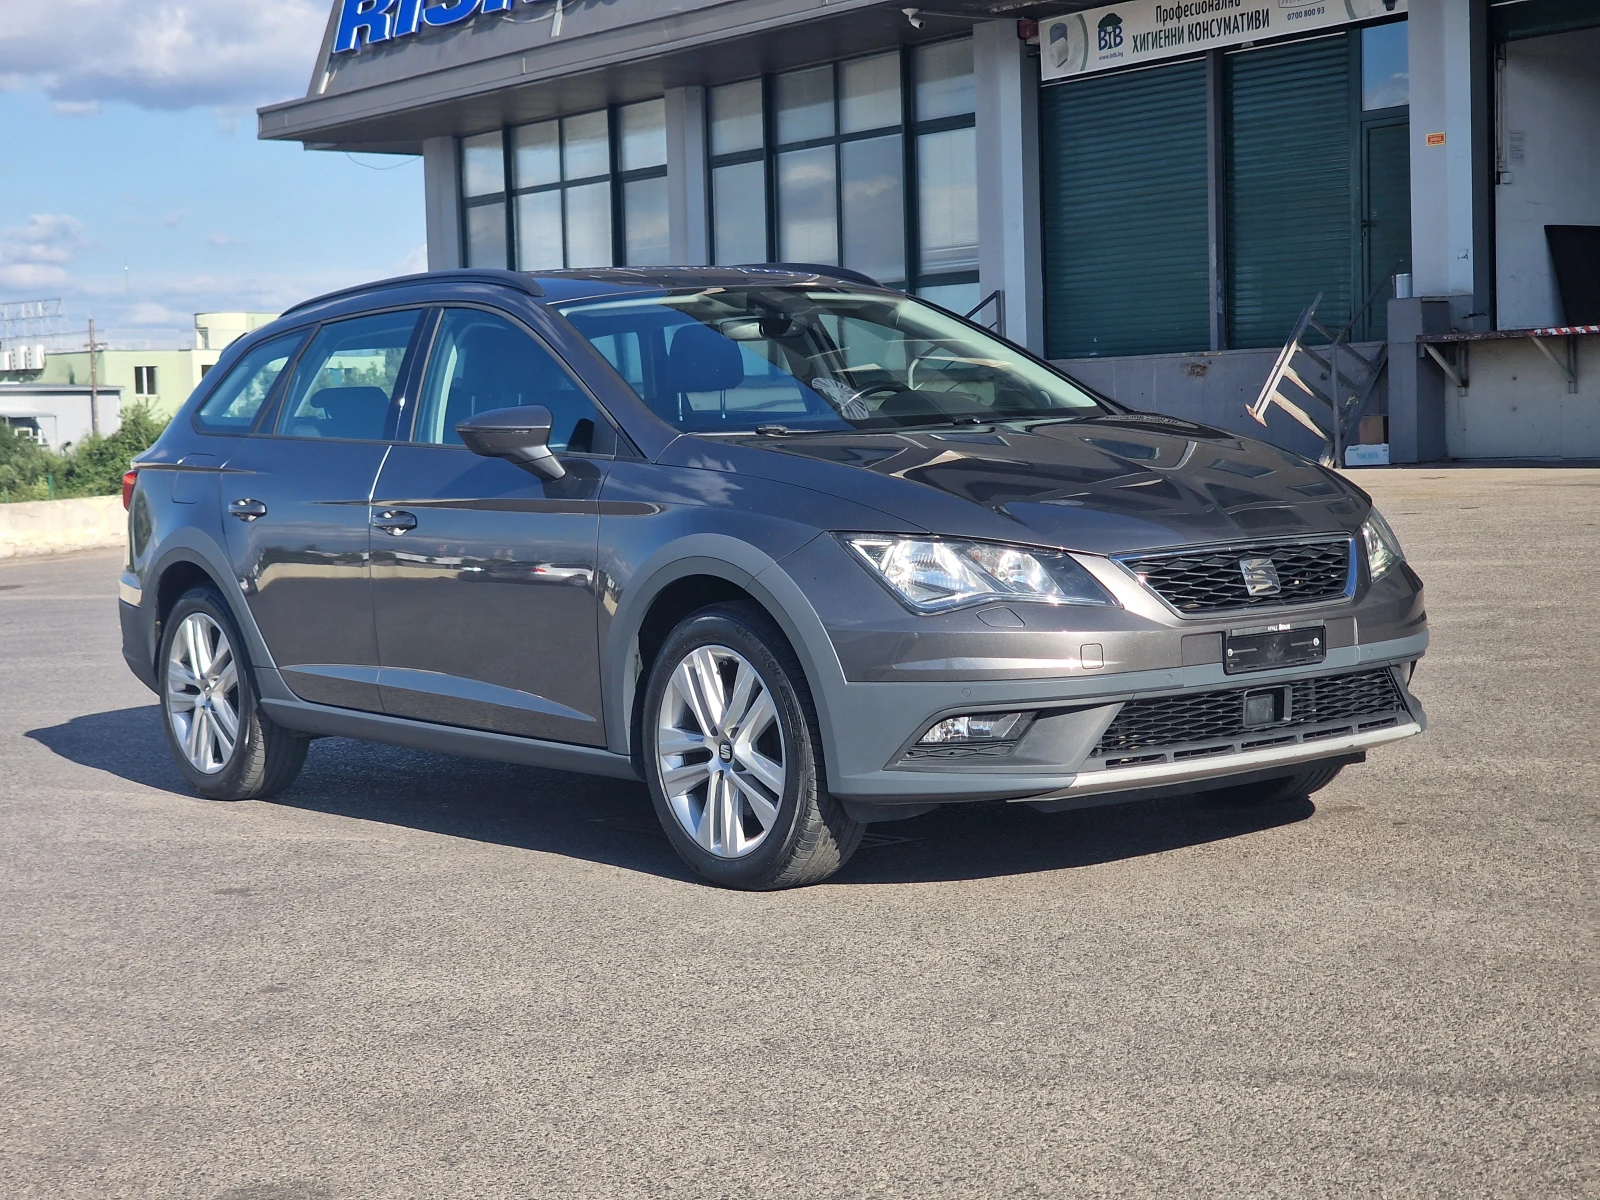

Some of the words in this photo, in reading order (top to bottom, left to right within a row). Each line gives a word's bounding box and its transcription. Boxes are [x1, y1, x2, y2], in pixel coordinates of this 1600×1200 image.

[1287, 10, 1302, 20] 0700
[1304, 8, 1315, 17] 800
[1317, 6, 1325, 15] 93
[1132, 25, 1184, 53] ХИГИЕННИ
[1187, 9, 1269, 43] КОНСУМАТИВИ
